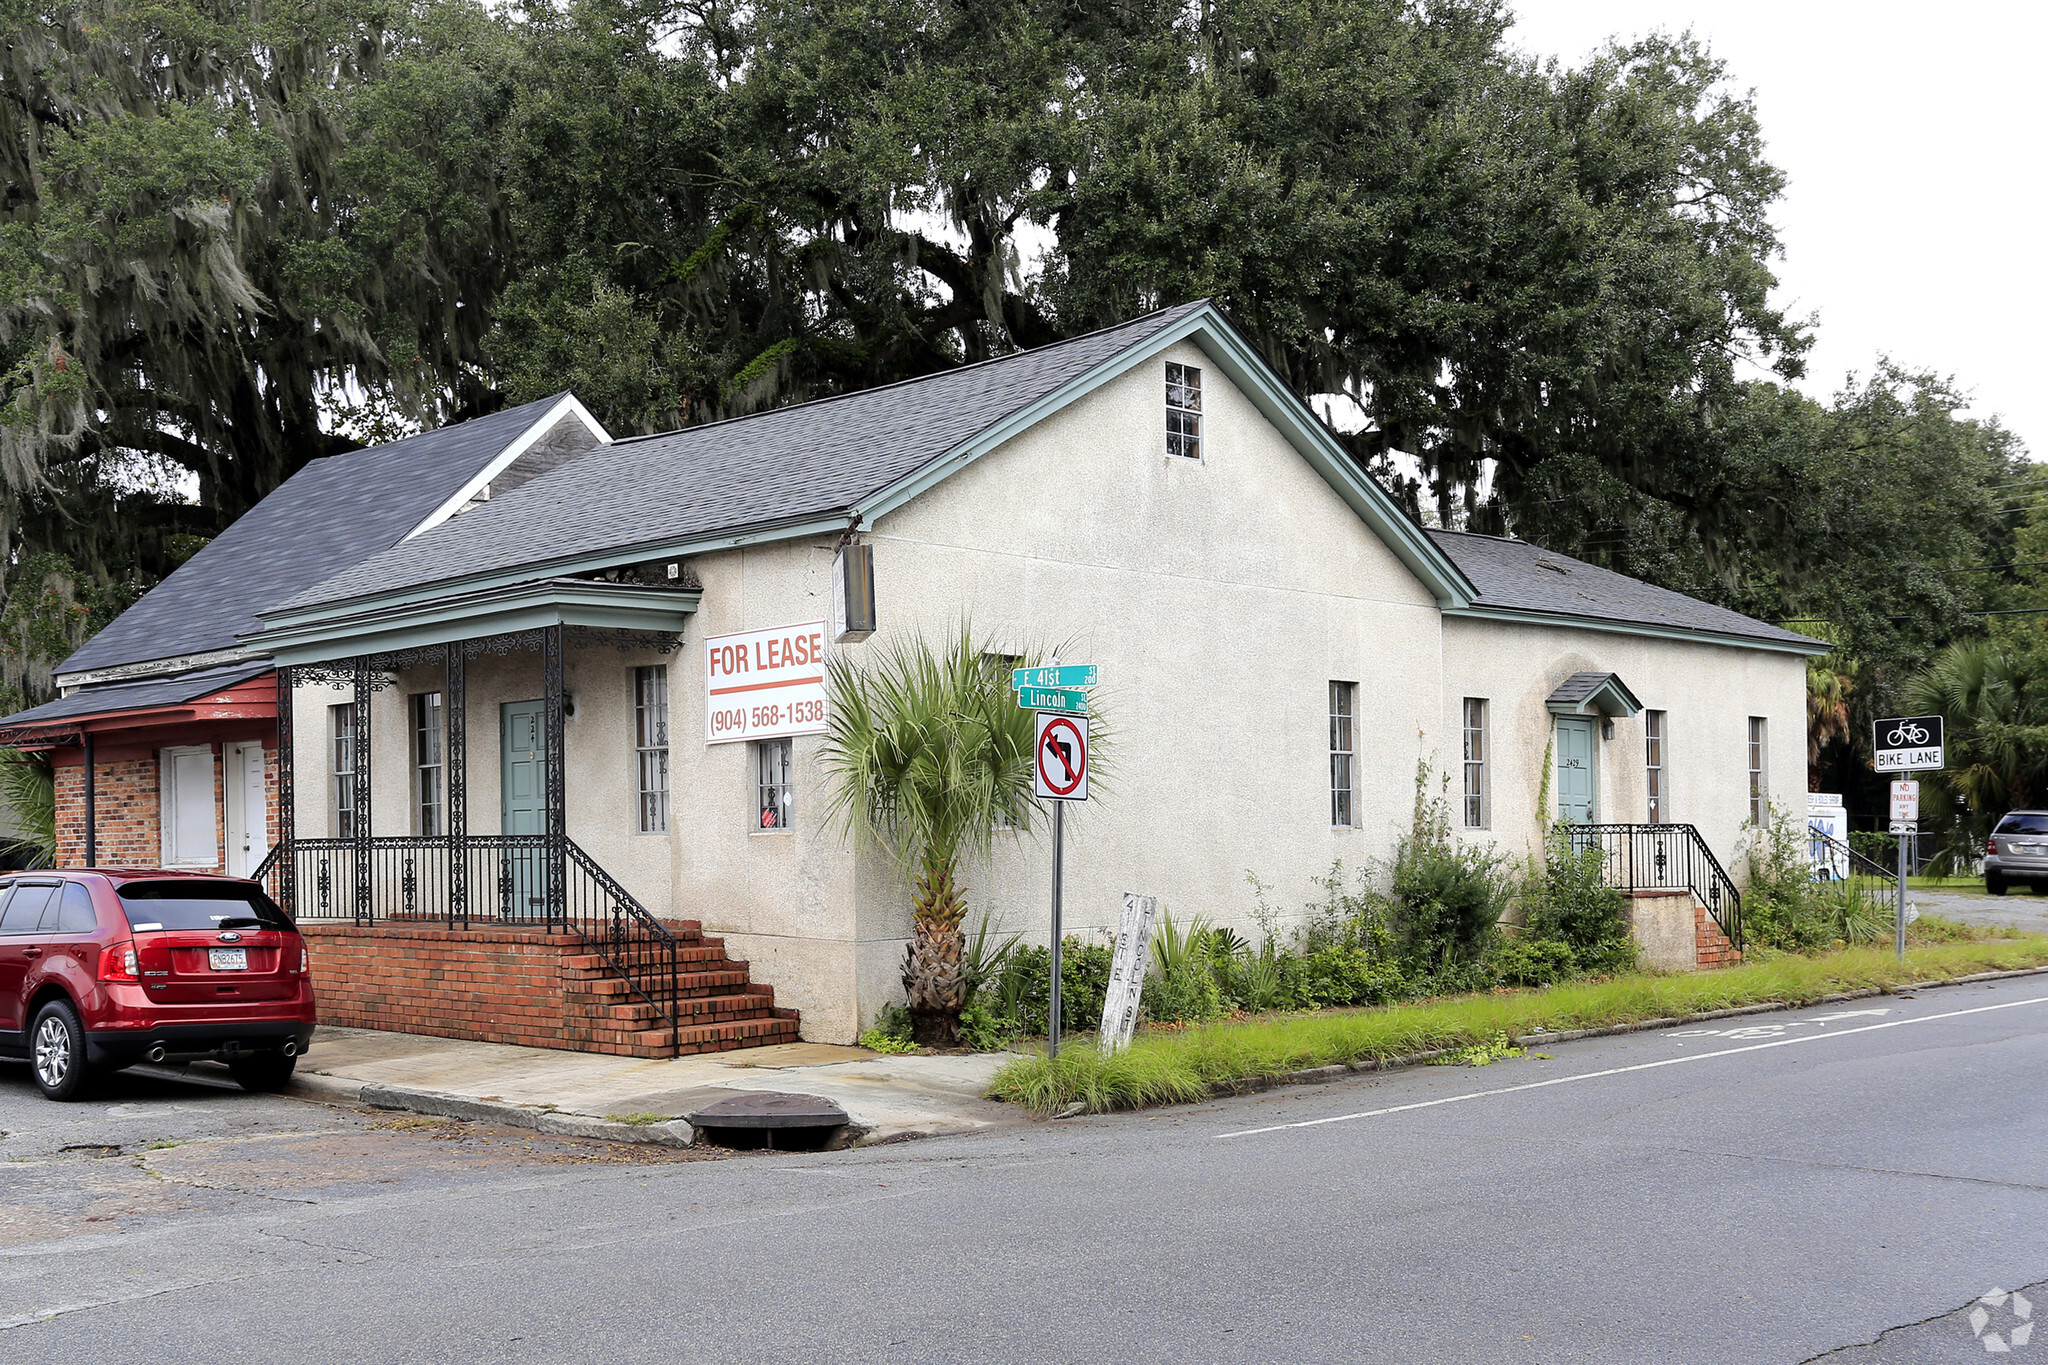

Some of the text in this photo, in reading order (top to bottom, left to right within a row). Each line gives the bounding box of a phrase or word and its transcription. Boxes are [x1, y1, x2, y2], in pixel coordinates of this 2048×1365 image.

[710, 633, 822, 677] FOR LEASE
[1037, 668, 1061, 687] 41st
[1030, 690, 1066, 708] Lincoln
[710, 699, 824, 736] (904) 568-1538
[1878, 751, 1939, 766] BIKE LANE
[1899, 784, 1910, 792] NO
